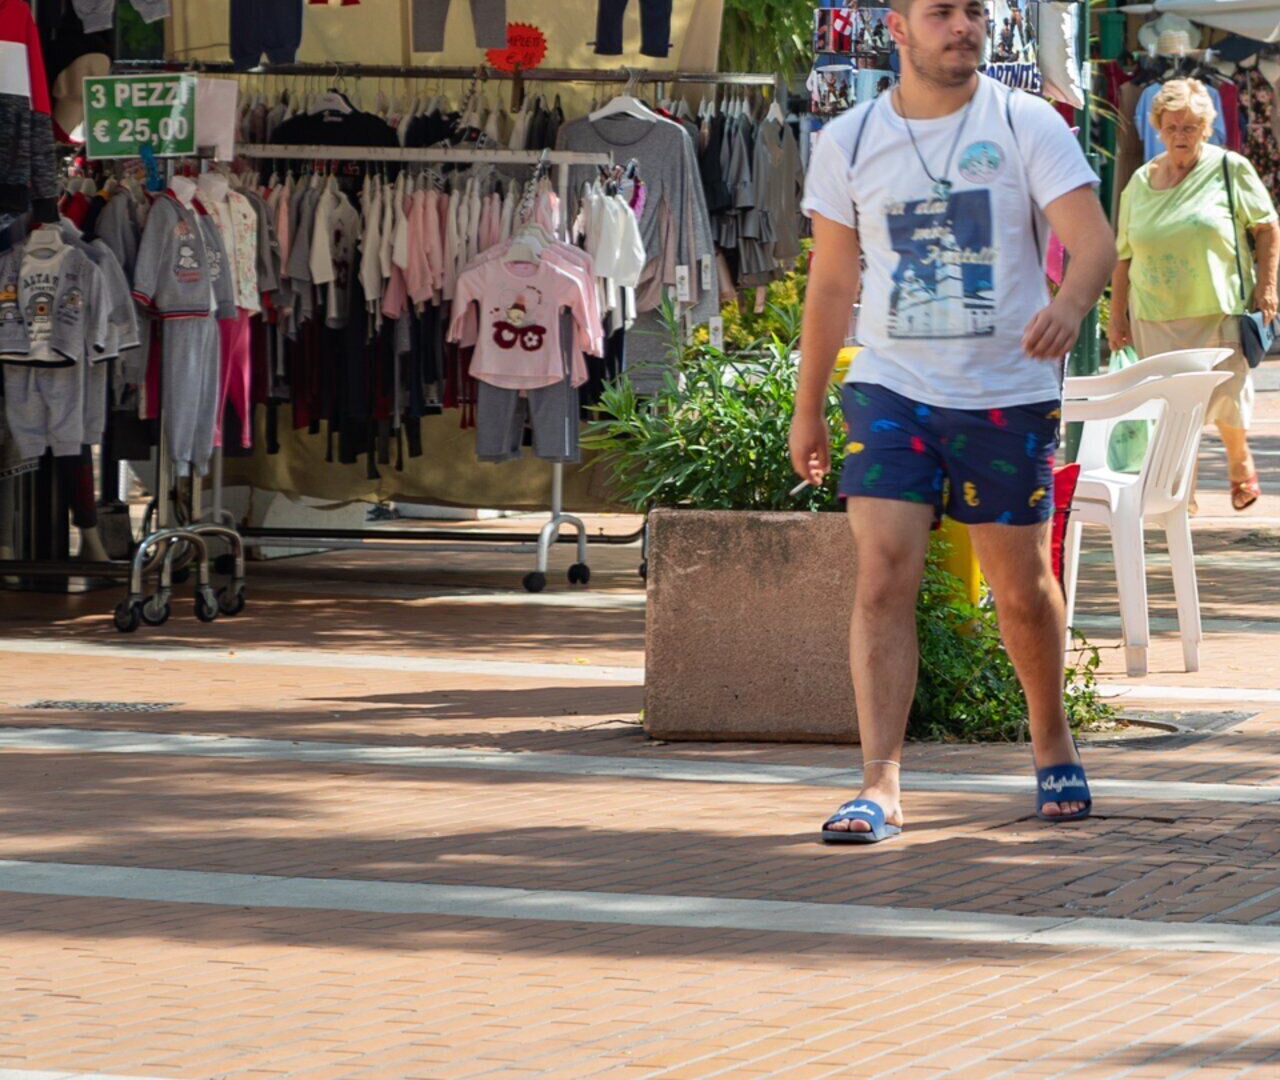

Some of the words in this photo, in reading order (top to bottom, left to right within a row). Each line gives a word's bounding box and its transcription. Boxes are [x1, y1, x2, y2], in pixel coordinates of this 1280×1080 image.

[90, 84, 106, 109] 3
[114, 81, 188, 108] PEZZI
[93, 119, 111, 143] €
[118, 116, 188, 146] 25,00
